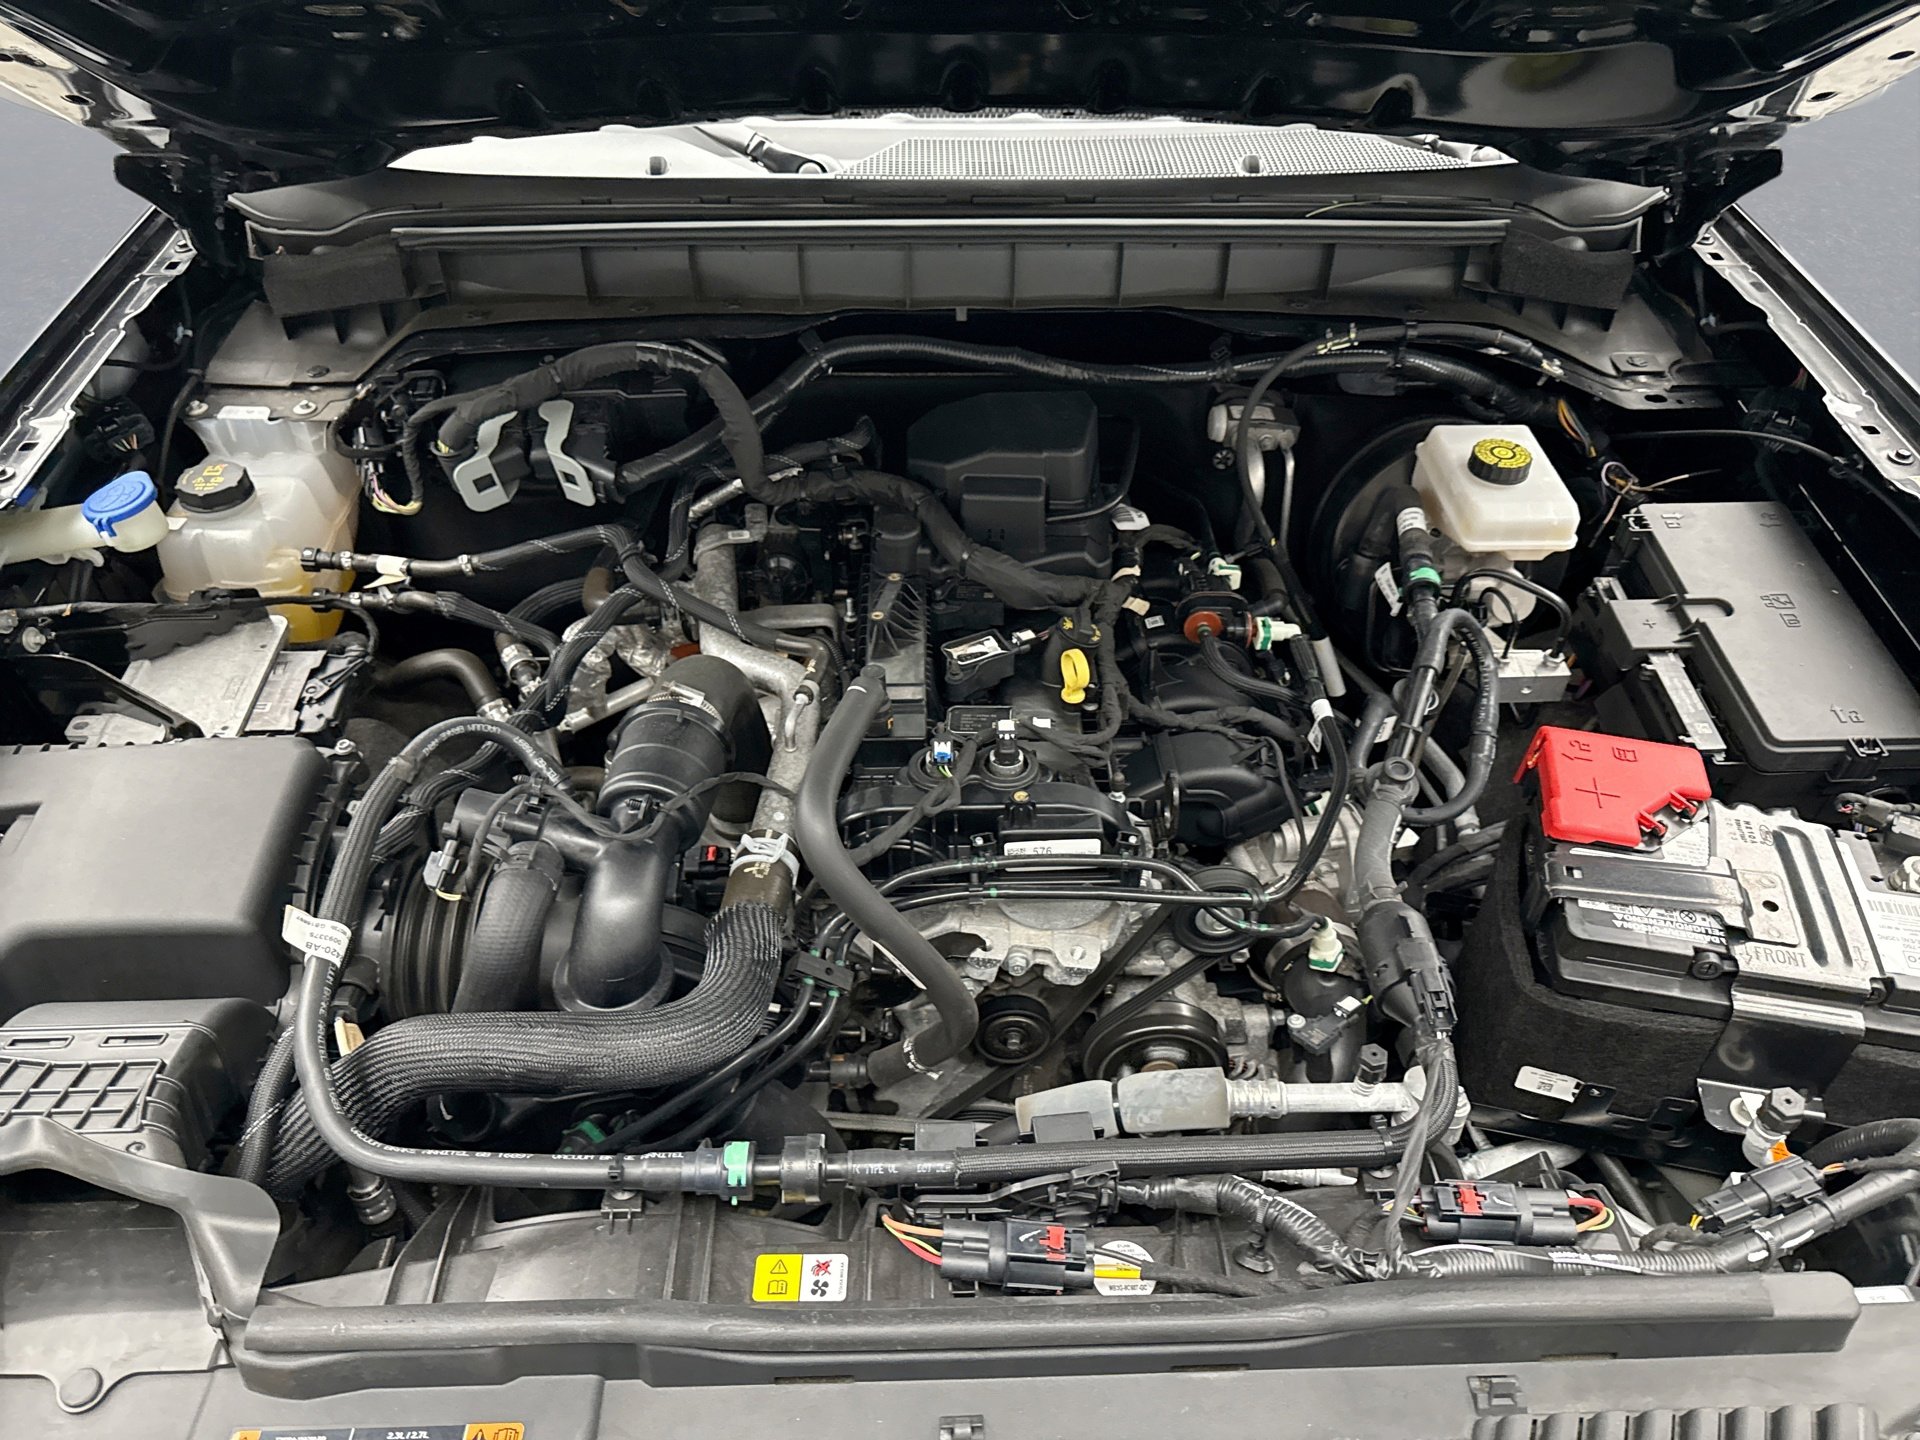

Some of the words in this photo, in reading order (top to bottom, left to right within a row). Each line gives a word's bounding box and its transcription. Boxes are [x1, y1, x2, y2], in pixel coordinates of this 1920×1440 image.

[467, 723, 502, 734] VACUUM
[1753, 946, 1806, 968] FRONT
[350, 1126, 382, 1149] VACUUM
[383, 1145, 417, 1155] BRAKE
[421, 1149, 470, 1158] ARNITEL
[640, 1152, 684, 1160] ARNITEL
[865, 1163, 884, 1175] TYPE
